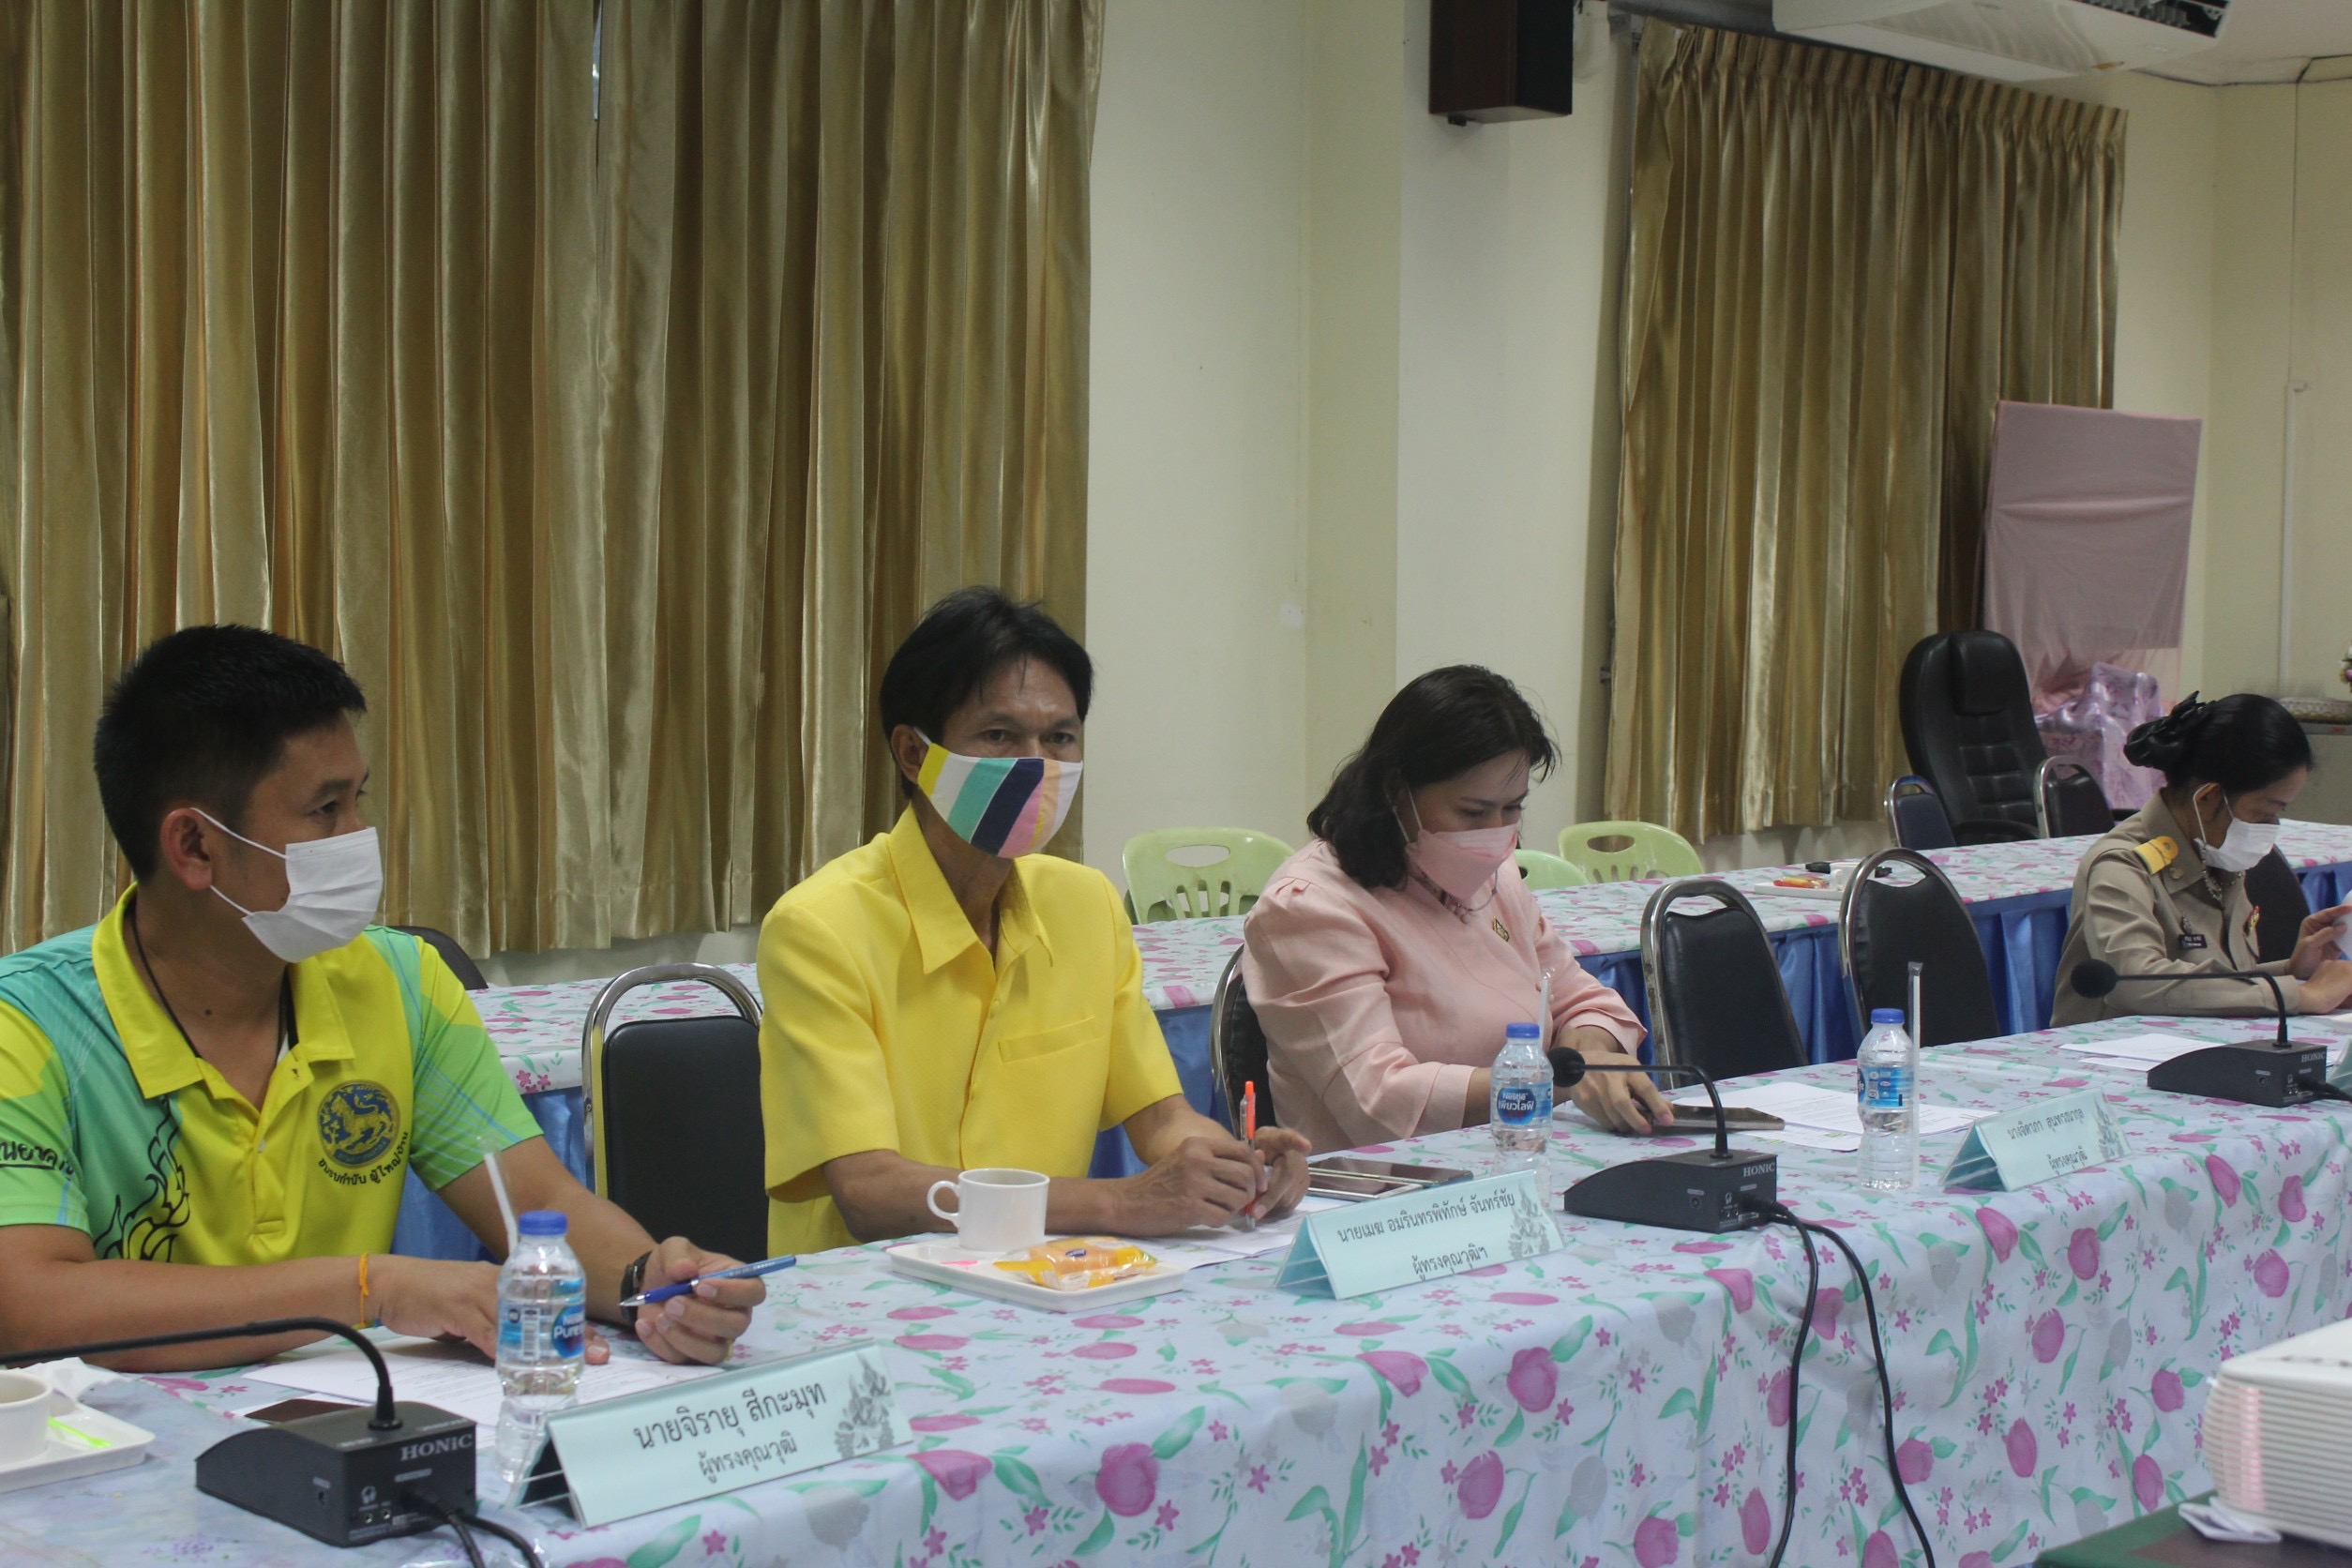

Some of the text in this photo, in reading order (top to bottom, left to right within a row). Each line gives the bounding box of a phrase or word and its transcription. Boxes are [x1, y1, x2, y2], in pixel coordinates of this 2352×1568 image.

[2300, 1051, 2326, 1063] HONIC
[1741, 1161, 1776, 1178] HONIC
[633, 1405, 746, 1450] นายจิรายุ
[400, 1433, 474, 1462] HONIC
[697, 1429, 797, 1485] ผู้ทรงคุณวุฒิ
